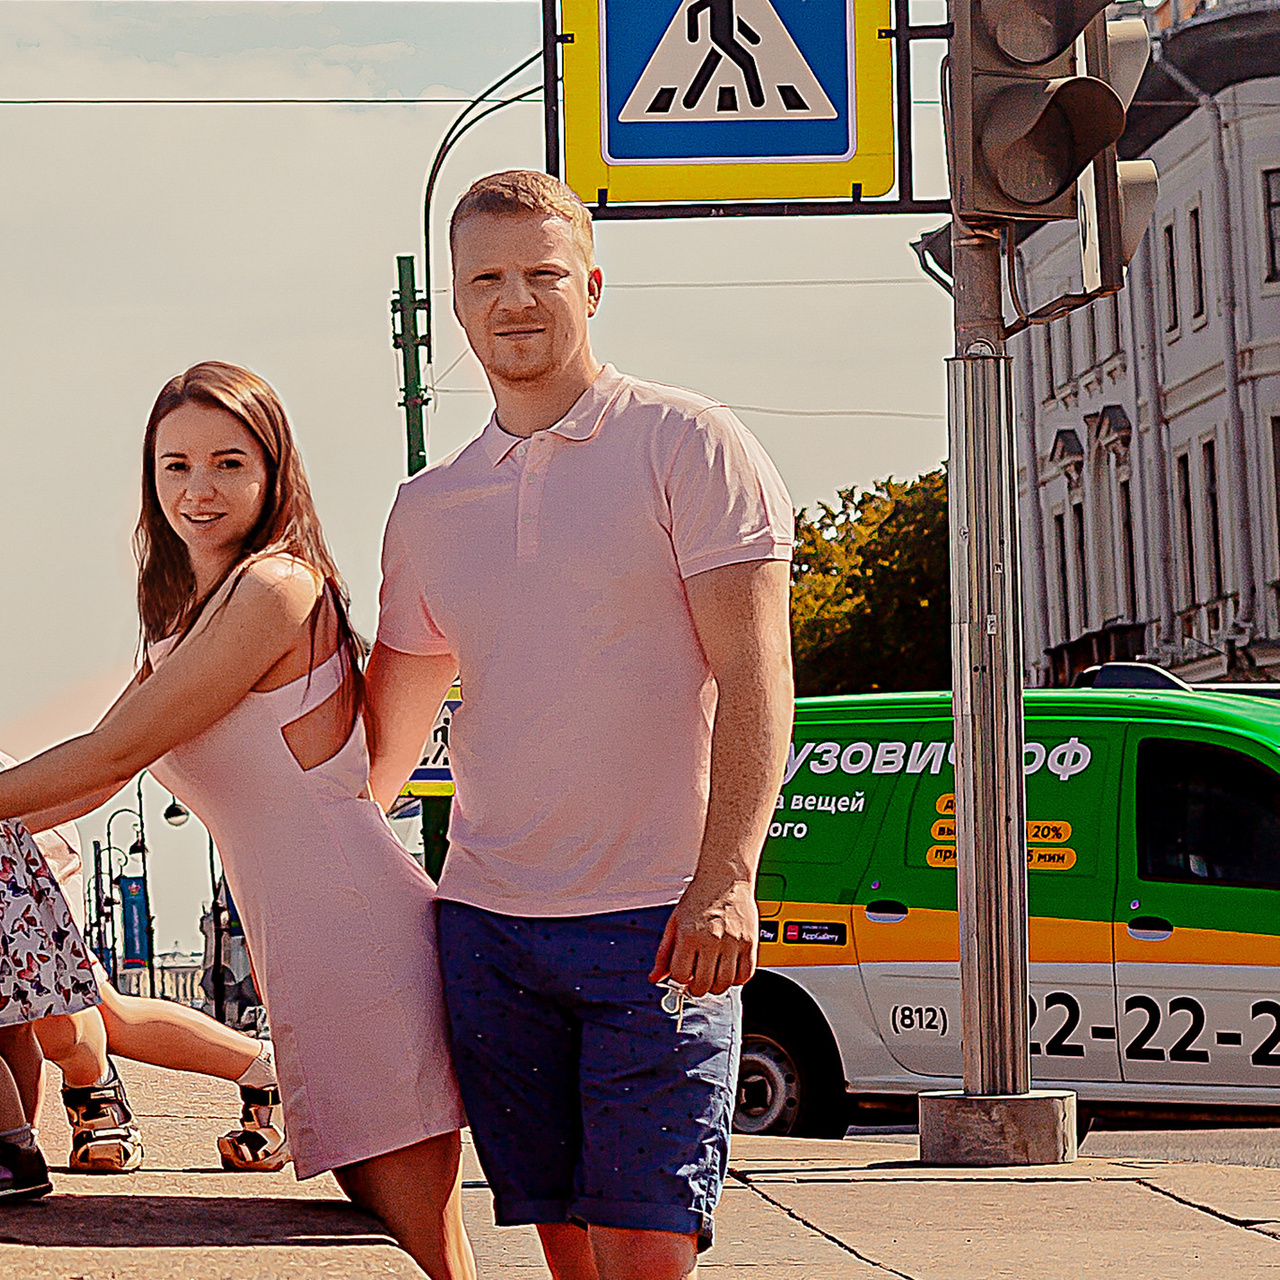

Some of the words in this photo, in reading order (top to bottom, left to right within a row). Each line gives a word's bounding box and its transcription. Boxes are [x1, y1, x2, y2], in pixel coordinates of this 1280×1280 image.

[791, 791, 865, 814] вещей
[1032, 825, 1063, 839] 20%
[1037, 853, 1065, 863] мин
[890, 1005, 949, 1035] (812)
